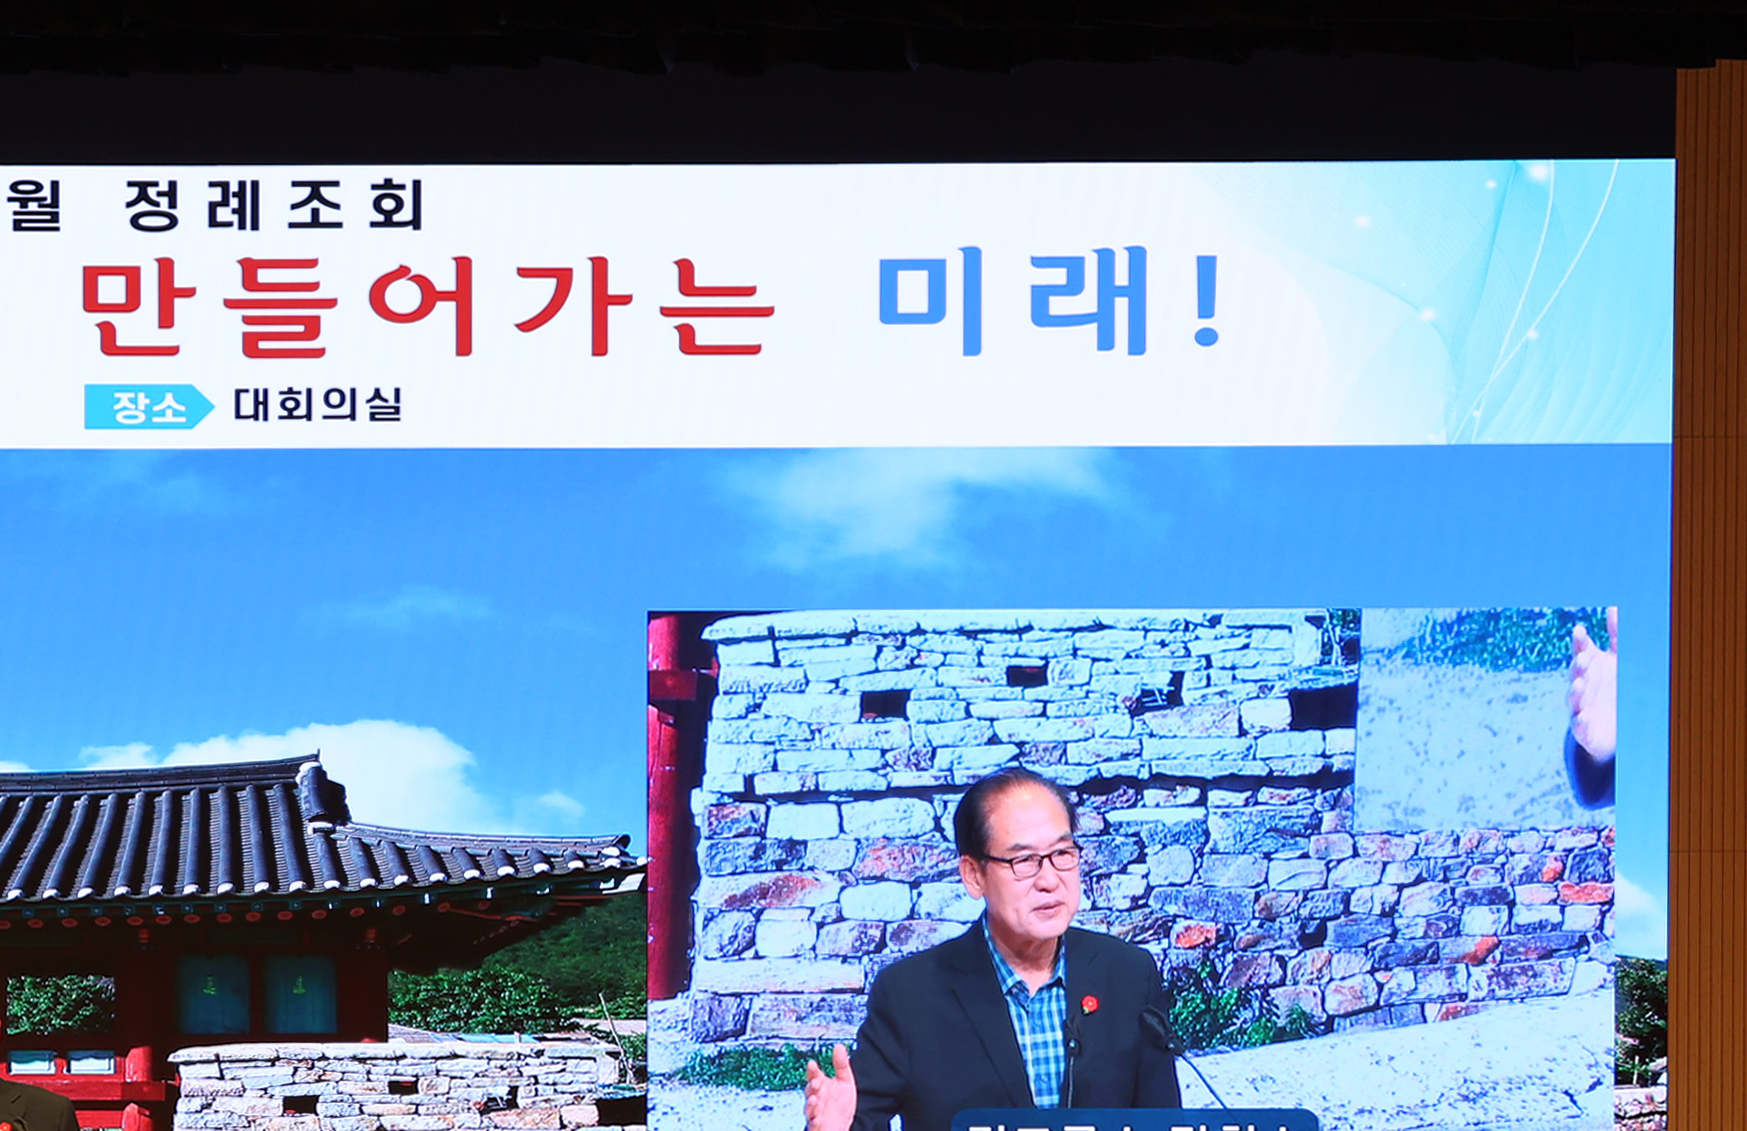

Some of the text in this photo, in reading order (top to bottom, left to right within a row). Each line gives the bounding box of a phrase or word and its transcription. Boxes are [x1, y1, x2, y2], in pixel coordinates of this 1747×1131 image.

[125, 177, 422, 233] 정례조회
[82, 255, 775, 359] 만들어가는
[879, 245, 1219, 357] 미래!
[112, 386, 402, 427] 장소 대회의실
